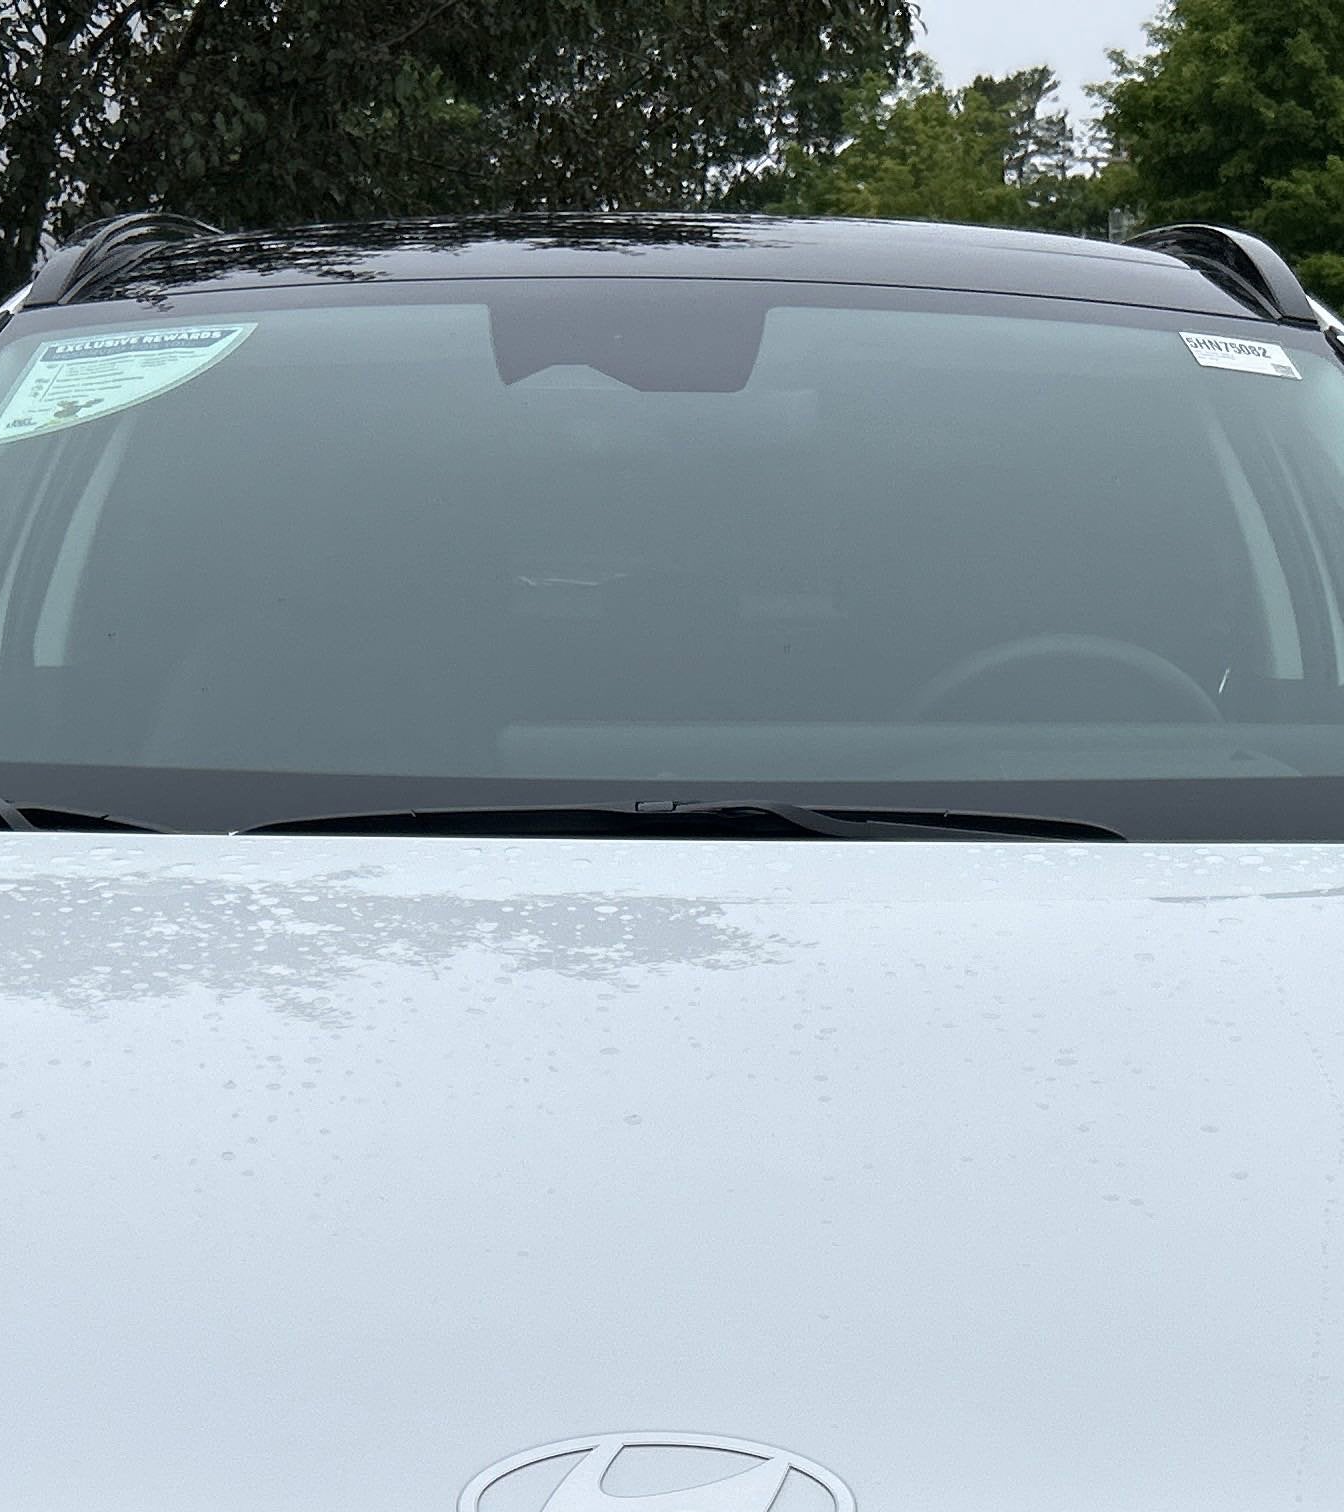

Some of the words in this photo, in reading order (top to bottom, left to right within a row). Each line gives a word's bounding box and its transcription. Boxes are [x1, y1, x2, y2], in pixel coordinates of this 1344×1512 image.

[55, 337, 139, 353] EXCLUSIVE
[142, 331, 222, 344] REWARDS
[1186, 337, 1272, 358] 5HN75082
